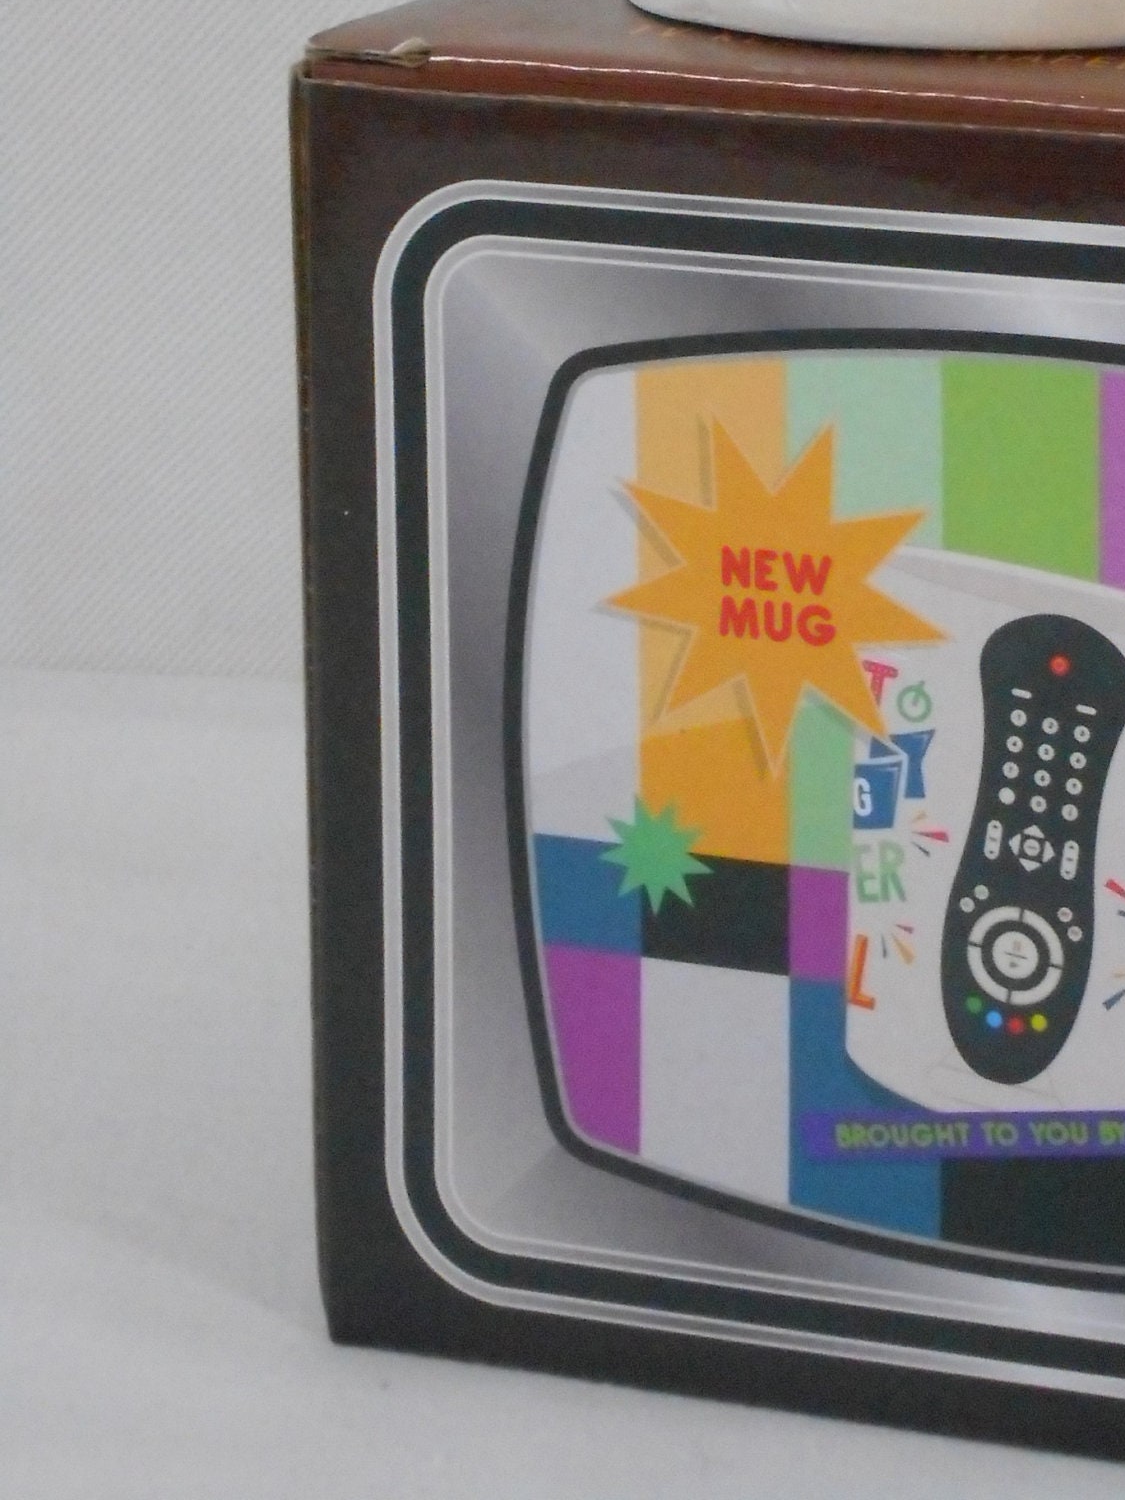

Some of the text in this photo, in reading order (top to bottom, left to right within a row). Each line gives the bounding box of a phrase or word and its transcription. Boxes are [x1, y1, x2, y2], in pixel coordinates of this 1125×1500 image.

[720, 544, 833, 597] NEW
[718, 594, 837, 647] MUG
[834, 1120, 970, 1150] BROUGHT
[982, 1121, 1019, 1148] TO
[1028, 1120, 1089, 1148] YOU
